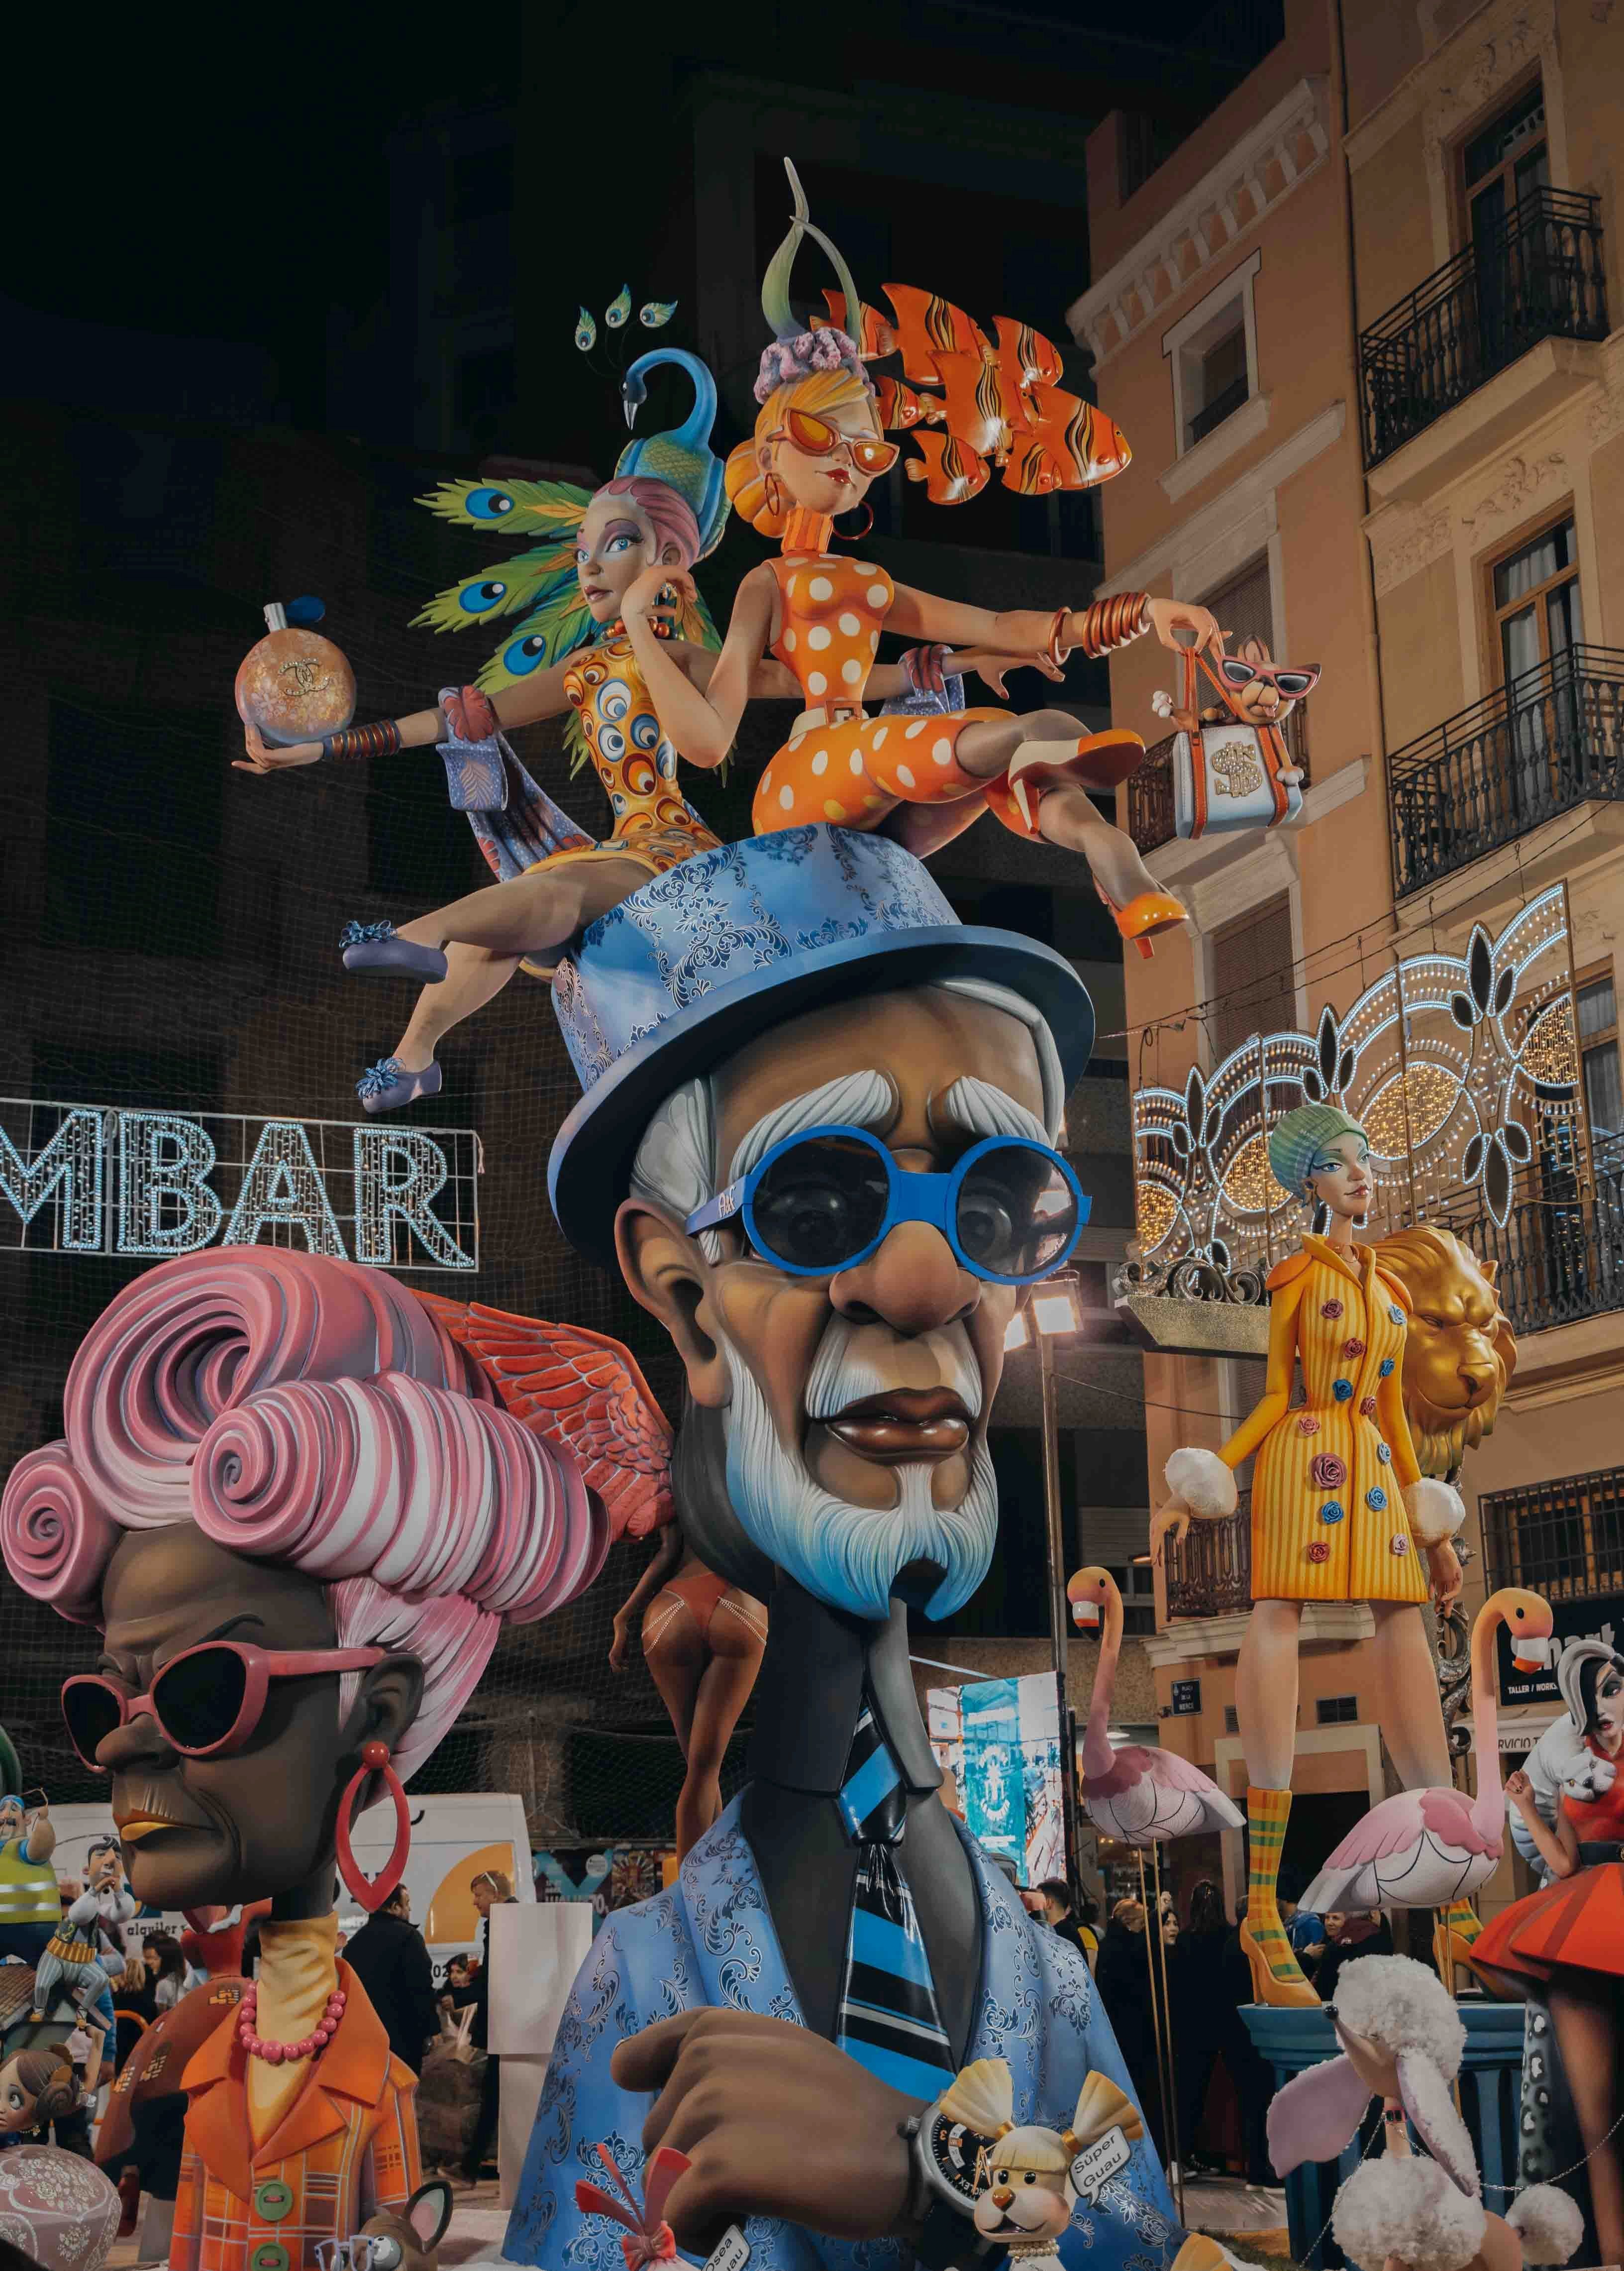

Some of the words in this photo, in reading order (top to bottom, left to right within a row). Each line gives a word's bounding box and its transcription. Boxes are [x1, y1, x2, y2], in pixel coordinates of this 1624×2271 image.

[1508, 1684, 1529, 1694] TALLER
[1075, 2135, 1115, 2174] Súper
[1084, 2153, 1122, 2187] Guau
